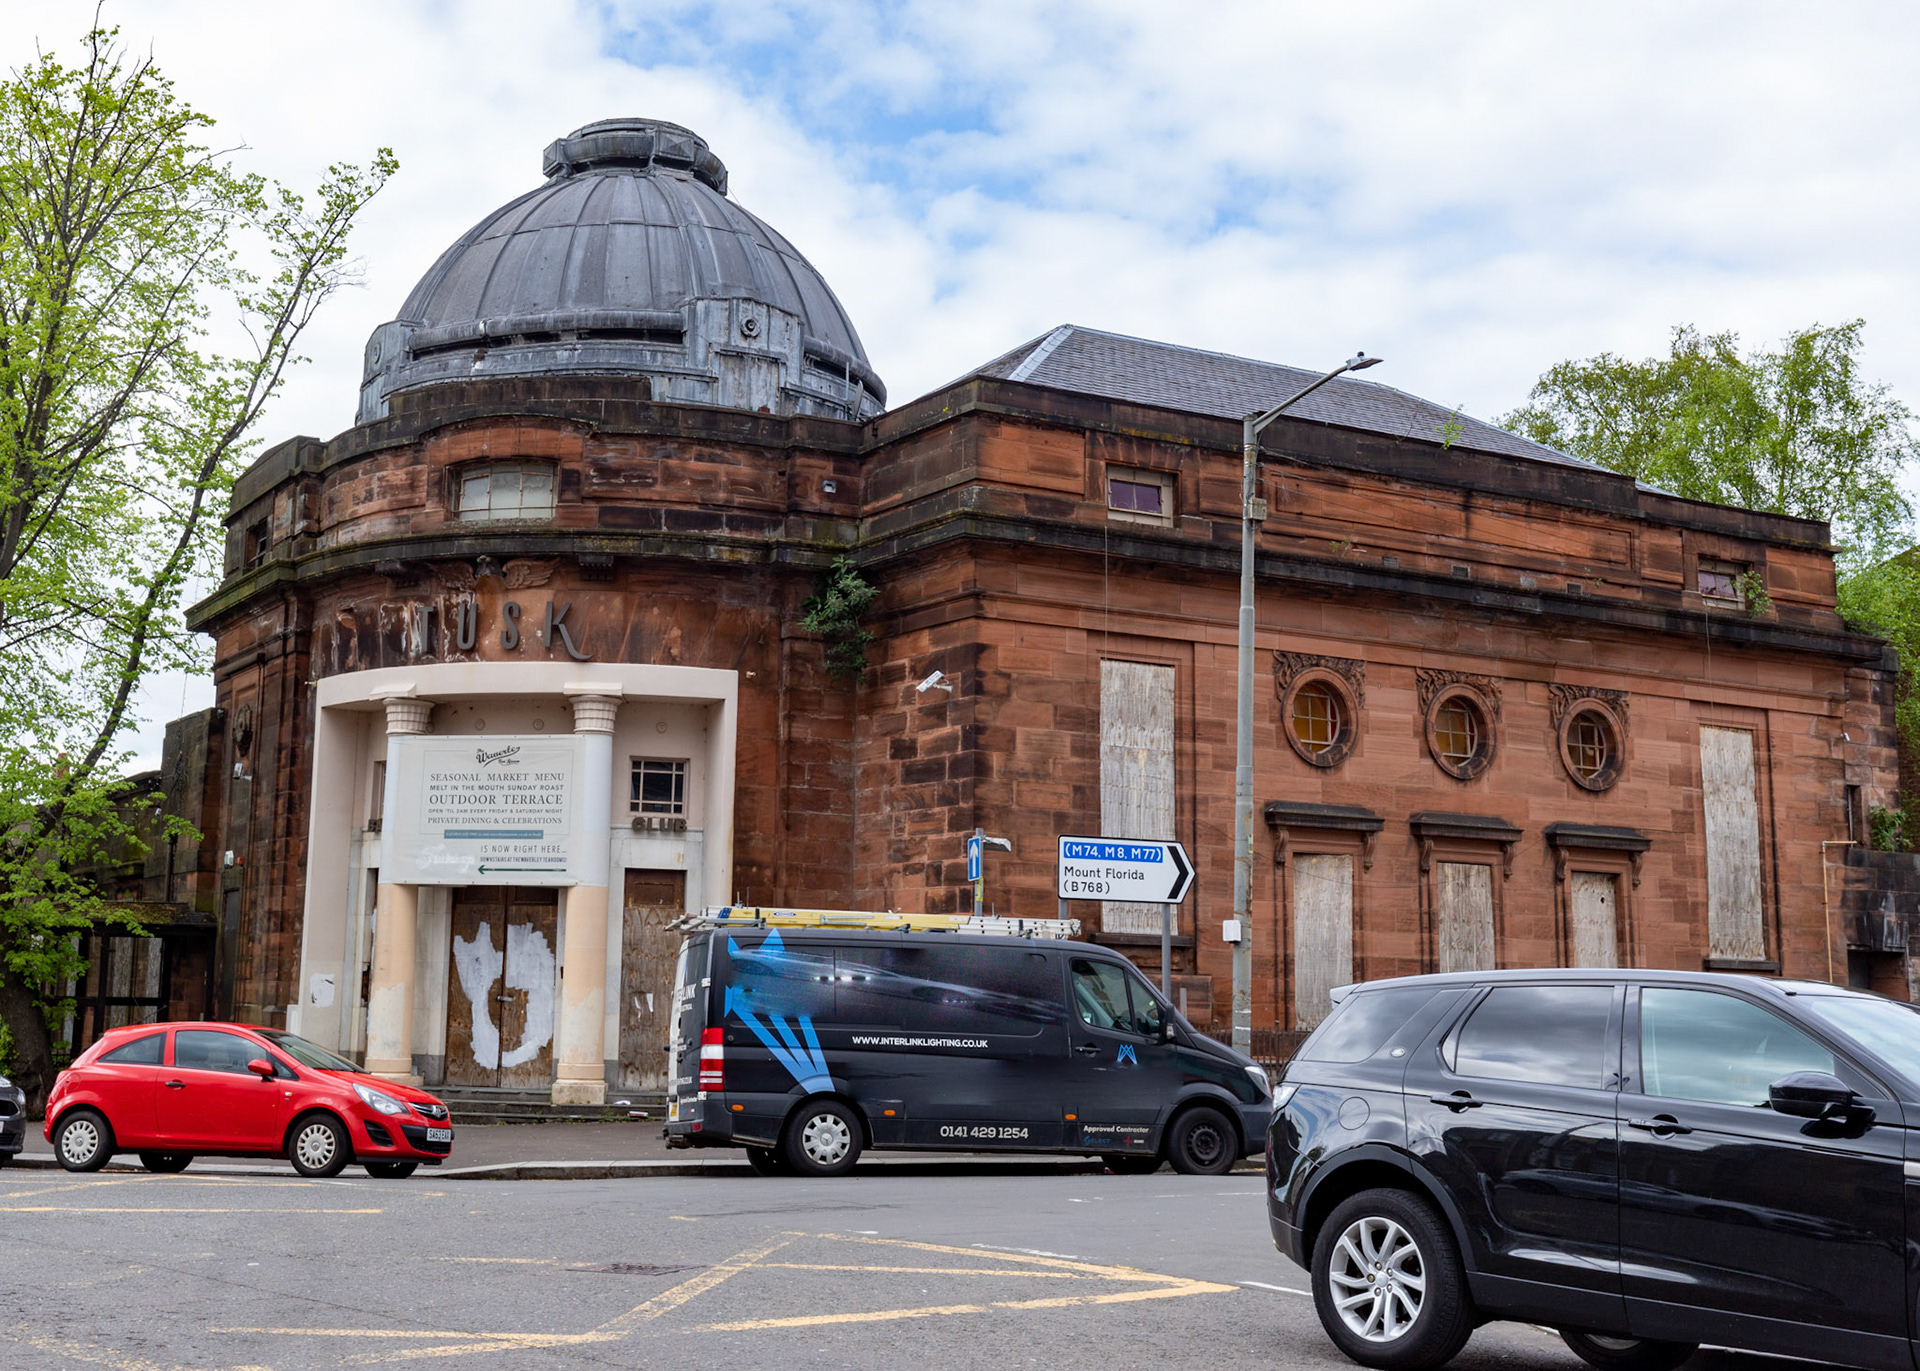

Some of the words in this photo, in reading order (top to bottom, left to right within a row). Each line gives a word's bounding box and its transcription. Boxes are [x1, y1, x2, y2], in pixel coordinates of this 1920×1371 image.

[417, 600, 594, 662] TUSK
[430, 773, 481, 781] SEASONAL
[487, 773, 529, 781] MARKET
[535, 773, 564, 781] MENU
[429, 794, 497, 805] OUTDOOR
[502, 794, 563, 805] TERRACE
[480, 845, 488, 853] IS
[492, 845, 510, 853] NOW
[514, 845, 537, 853] RIGHT
[1131, 847, 1162, 862] M77)
[1064, 866, 1101, 879] Mount
[1105, 868, 1145, 881] Florida
[1063, 880, 1111, 895] (B768)
[852, 1036, 988, 1048] WWW.INTERLINKLIGHTING.CO.UK
[940, 1126, 968, 1138] 0141
[970, 1127, 997, 1138] 429
[998, 1127, 1029, 1139] 1254
[1083, 1125, 1115, 1133] Approved
